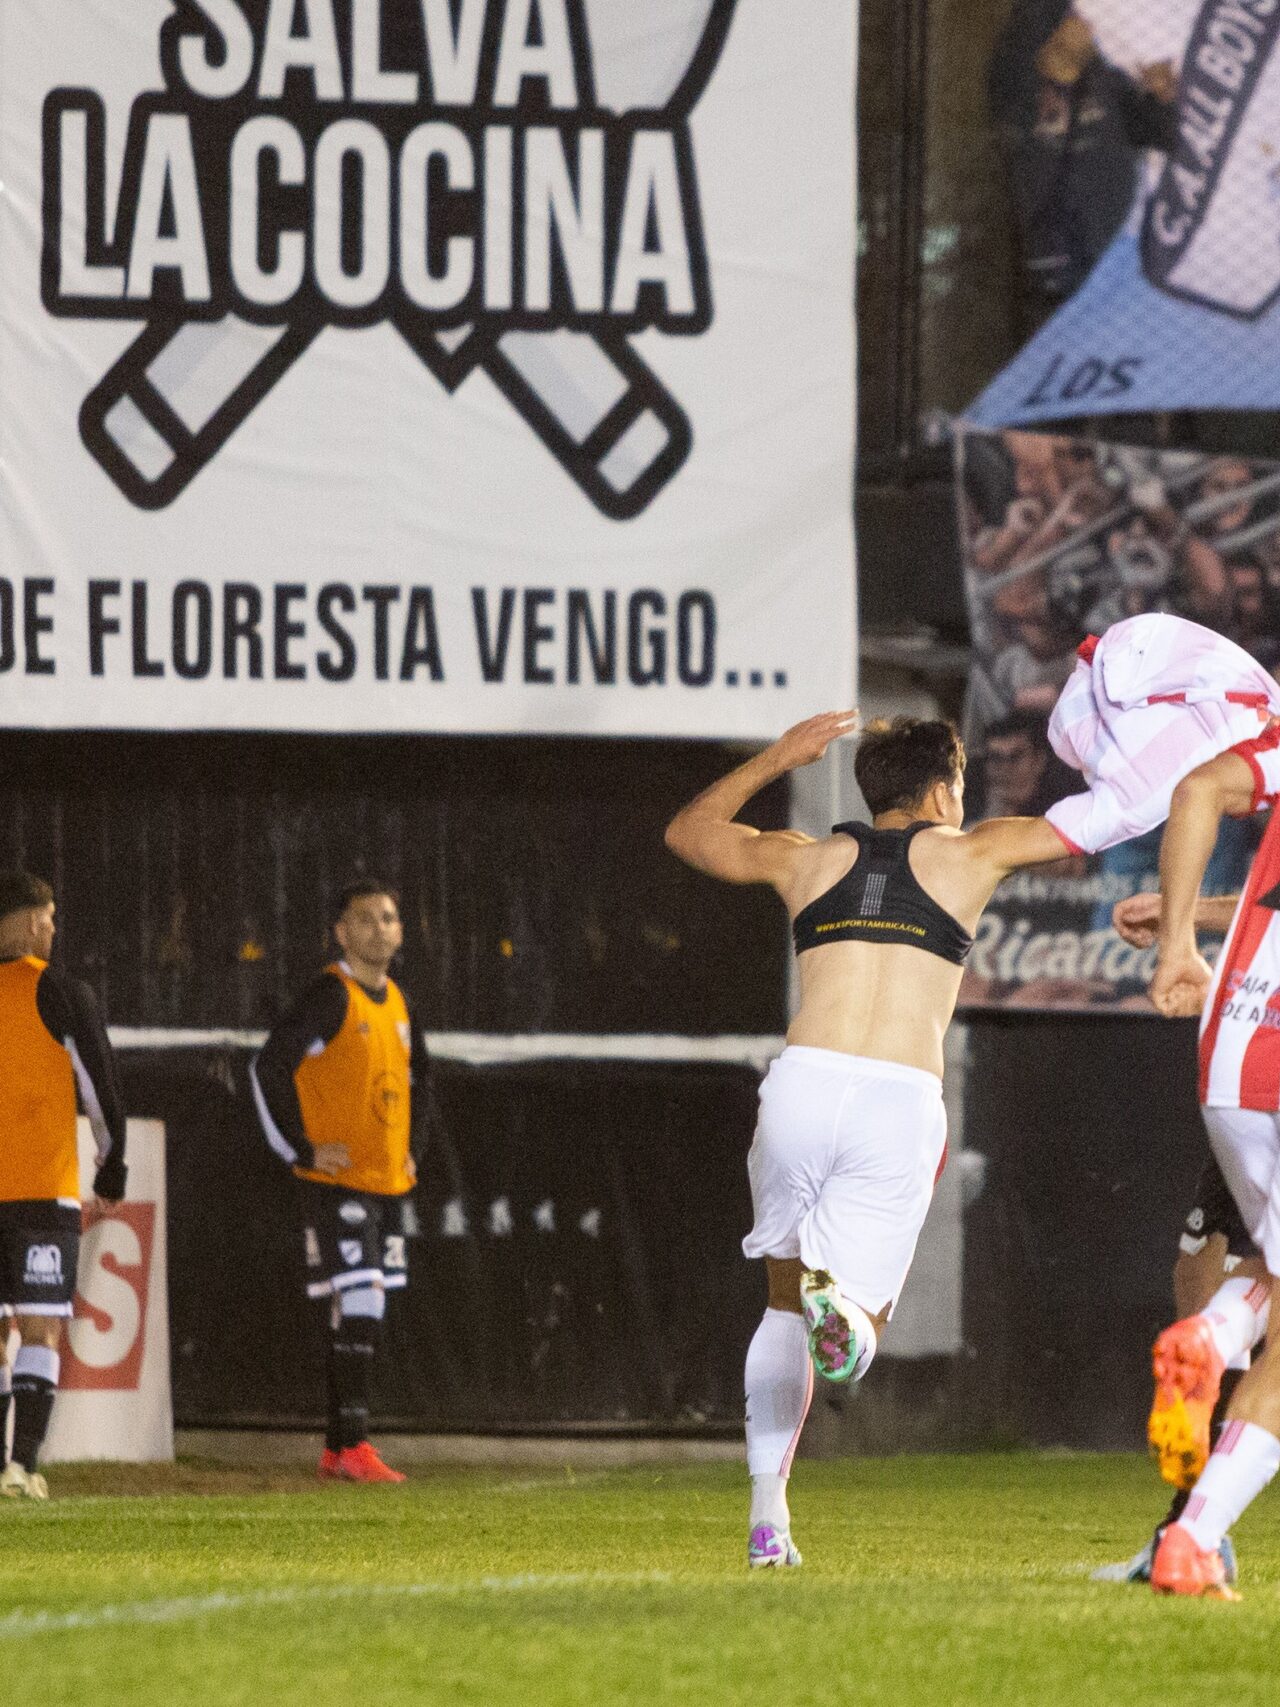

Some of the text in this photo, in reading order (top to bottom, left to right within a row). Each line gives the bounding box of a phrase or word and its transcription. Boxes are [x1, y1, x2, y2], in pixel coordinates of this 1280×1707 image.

[58, 109, 697, 315] LA COCINA
[89, 579, 444, 682] FLORESTA
[472, 588, 788, 687] VENGO...
